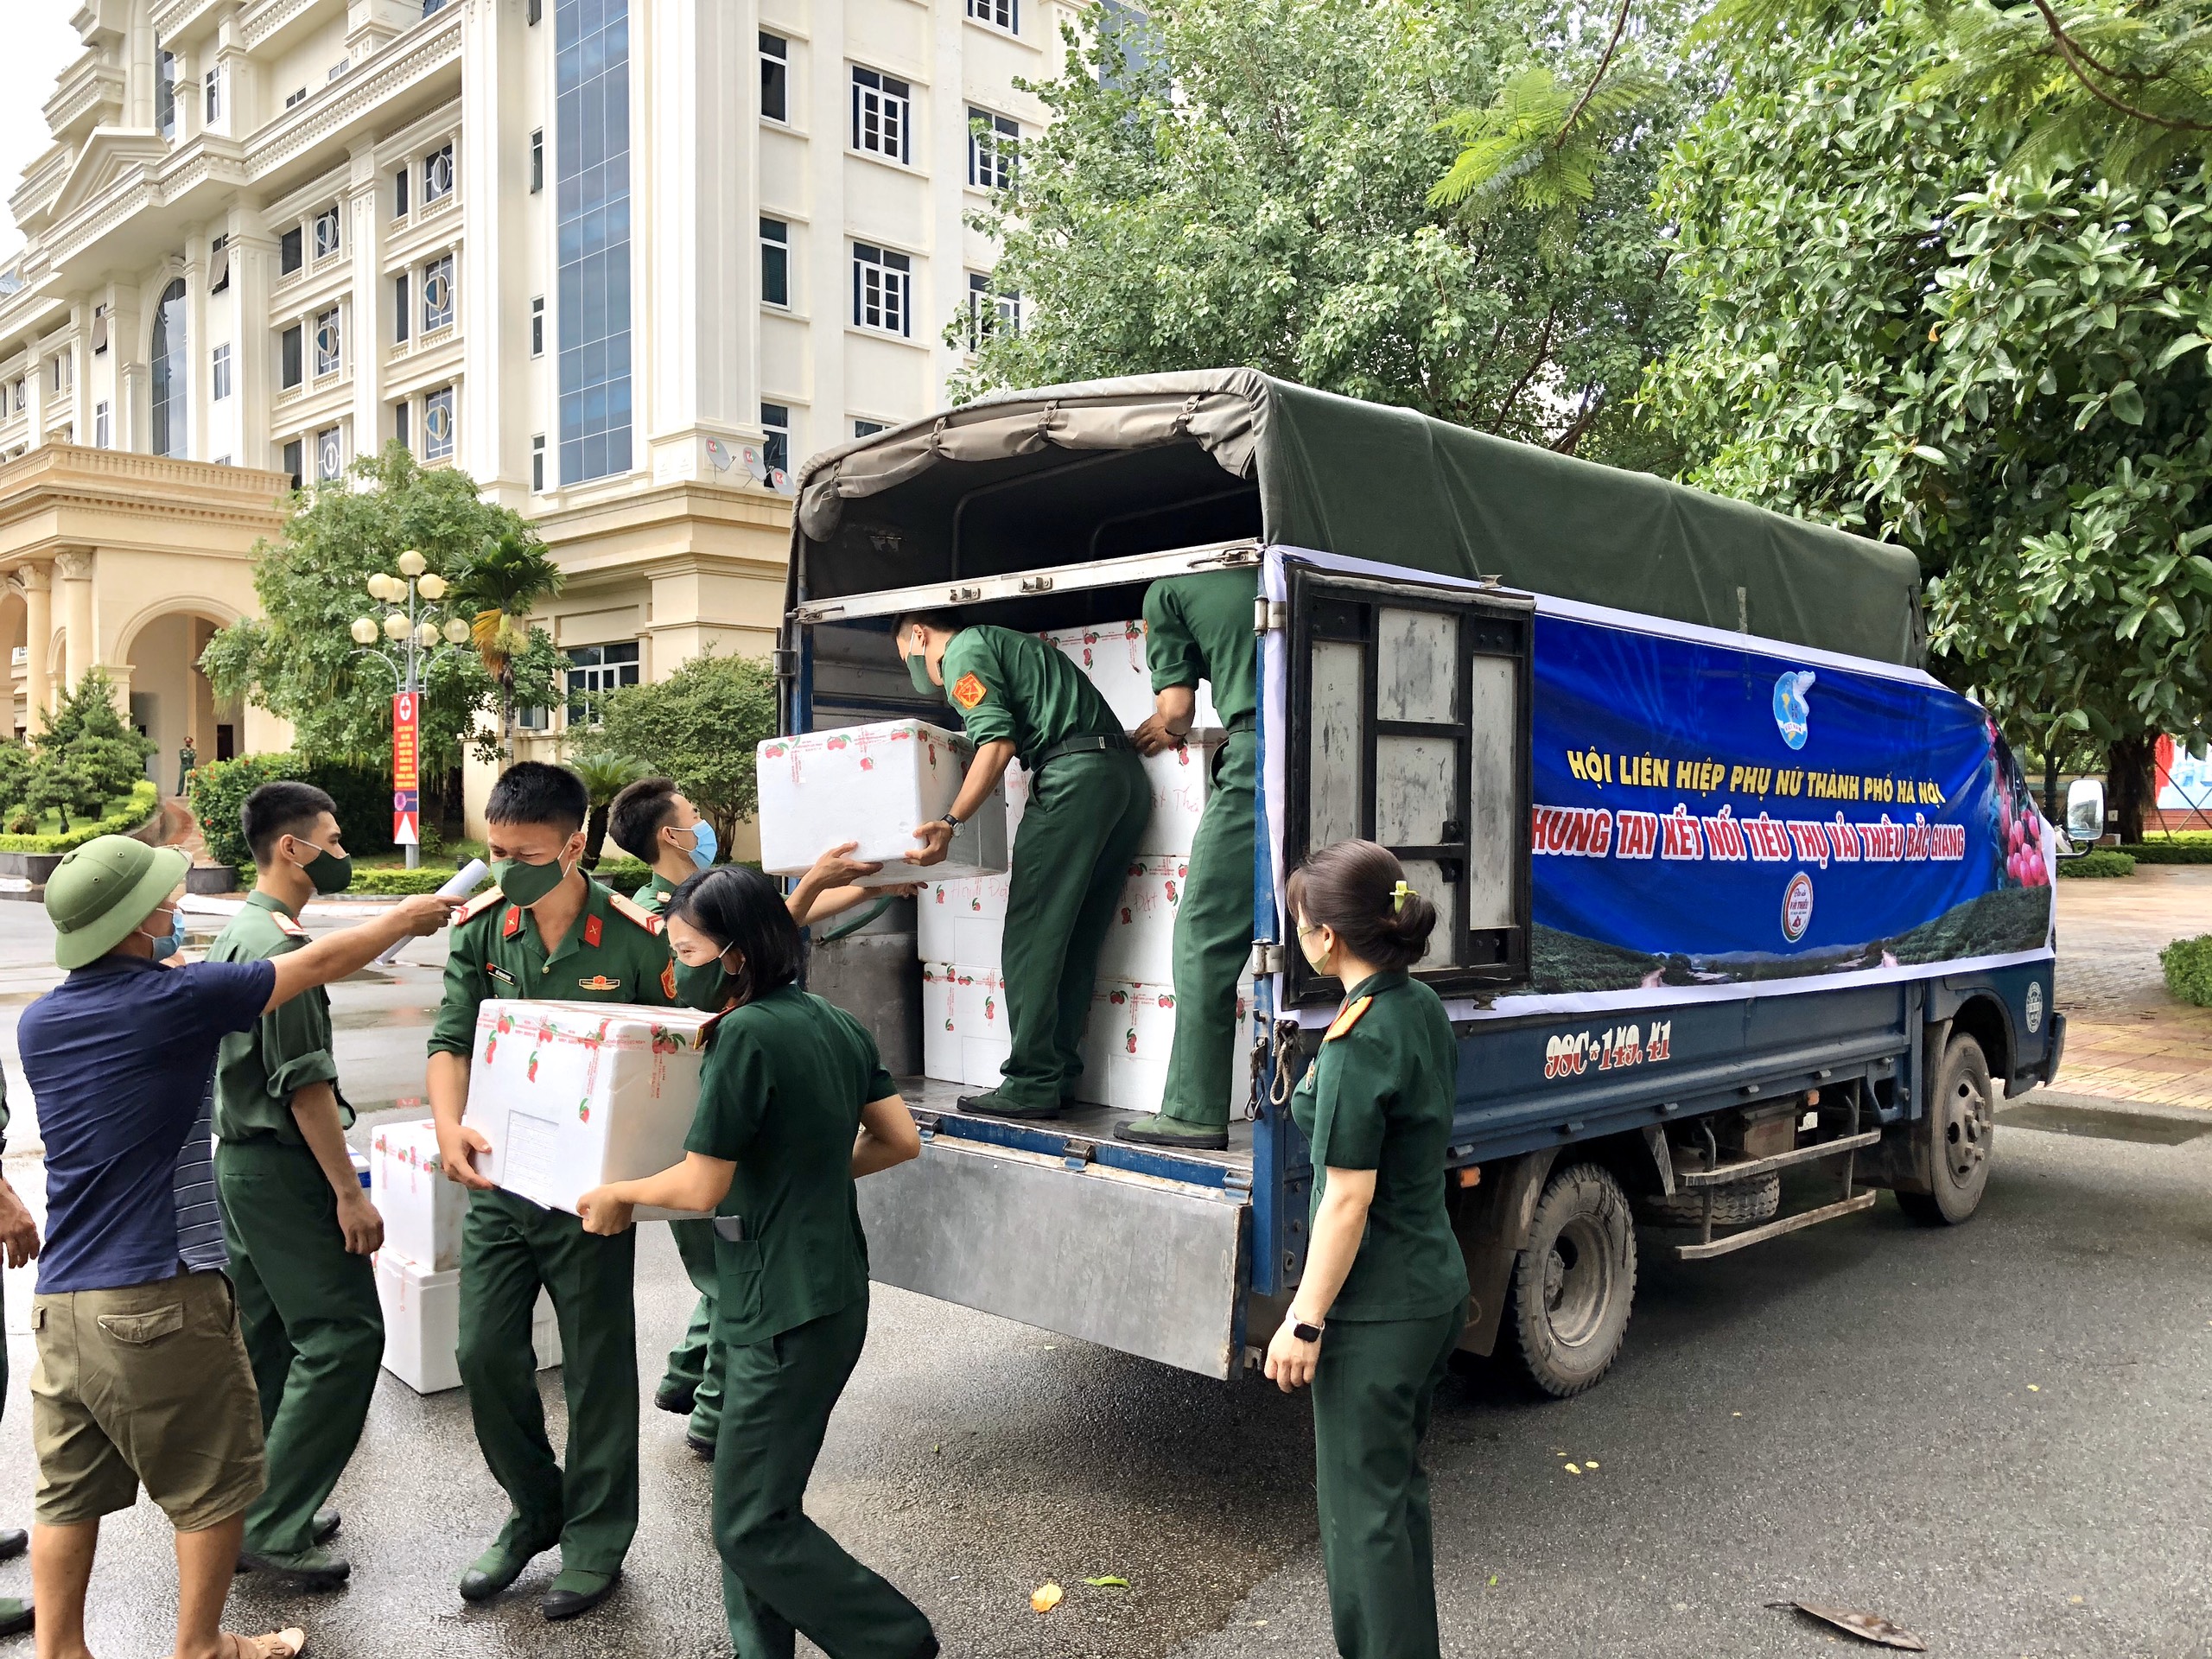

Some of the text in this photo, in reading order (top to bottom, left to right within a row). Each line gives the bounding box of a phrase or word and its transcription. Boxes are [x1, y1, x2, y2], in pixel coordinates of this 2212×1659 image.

[1567, 746, 1612, 790] HỘI
[1619, 751, 1669, 788] LIÊN
[1676, 756, 1726, 798] HIỆP
[1729, 766, 1771, 802] PHỤ
[1807, 768, 1859, 800] THÀNH
[1863, 771, 1893, 803] PHỐ
[1897, 776, 1916, 804] HÀ
[1531, 803, 1966, 869] HUNG TAY KẾT NỐI TIÊU THỤ VẢI THIỀU BẮC GIANG
